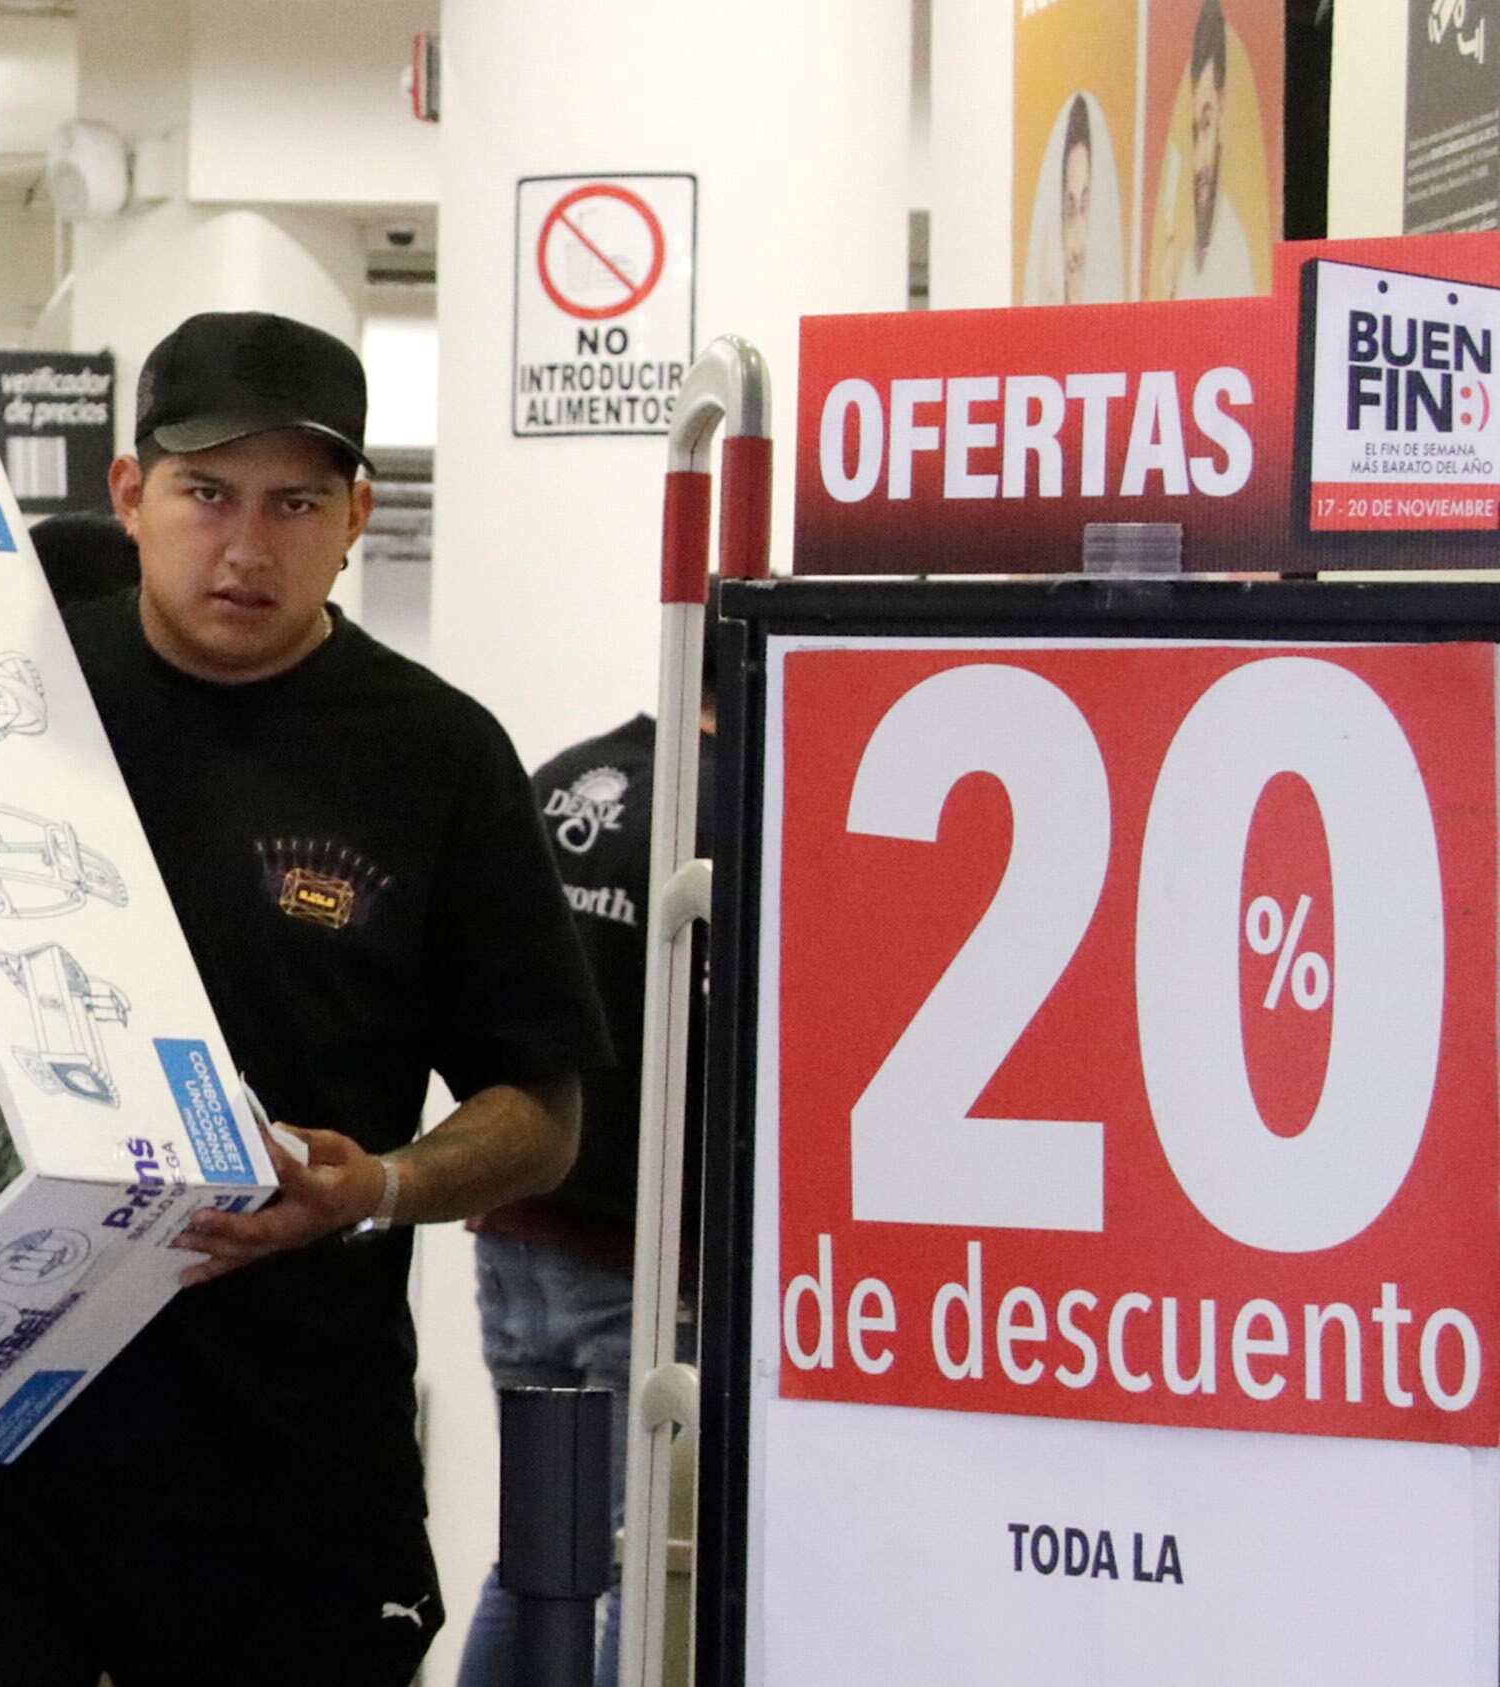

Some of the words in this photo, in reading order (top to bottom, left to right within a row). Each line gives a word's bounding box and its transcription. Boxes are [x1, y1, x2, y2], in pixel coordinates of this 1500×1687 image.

[577, 327, 628, 355] NO
[1349, 310, 1491, 374] BUEN
[1, 366, 110, 397] verificador
[521, 363, 683, 393] INTRODUCIR
[3, 395, 33, 425] de
[32, 398, 108, 430] precios
[819, 366, 1254, 503] OFERTAS
[1351, 457, 1378, 474] MÁS
[1382, 460, 1433, 474] BARATO
[1436, 460, 1458, 474] DEL
[1462, 457, 1493, 475] AÑO
[1365, 443, 1377, 456] EL
[1380, 443, 1400, 456] FIN
[1404, 443, 1419, 456] DE
[1423, 443, 1476, 456] SEMANA
[1316, 499, 1334, 517] 17
[1348, 499, 1368, 517] 20
[1371, 499, 1392, 517] DE
[1397, 499, 1493, 517] NOVIEMBRE
[845, 656, 1446, 1254] 20
[1245, 893, 1332, 1010] %
[185, 1079, 229, 1173] UNICORNIO
[188, 1050, 222, 1113] COMBO
[213, 1112, 246, 1174] SWEET
[783, 1233, 897, 1374] de
[931, 1241, 1482, 1412] descuento
[1007, 1523, 1119, 1580] TODA
[1133, 1532, 1184, 1584] LA
